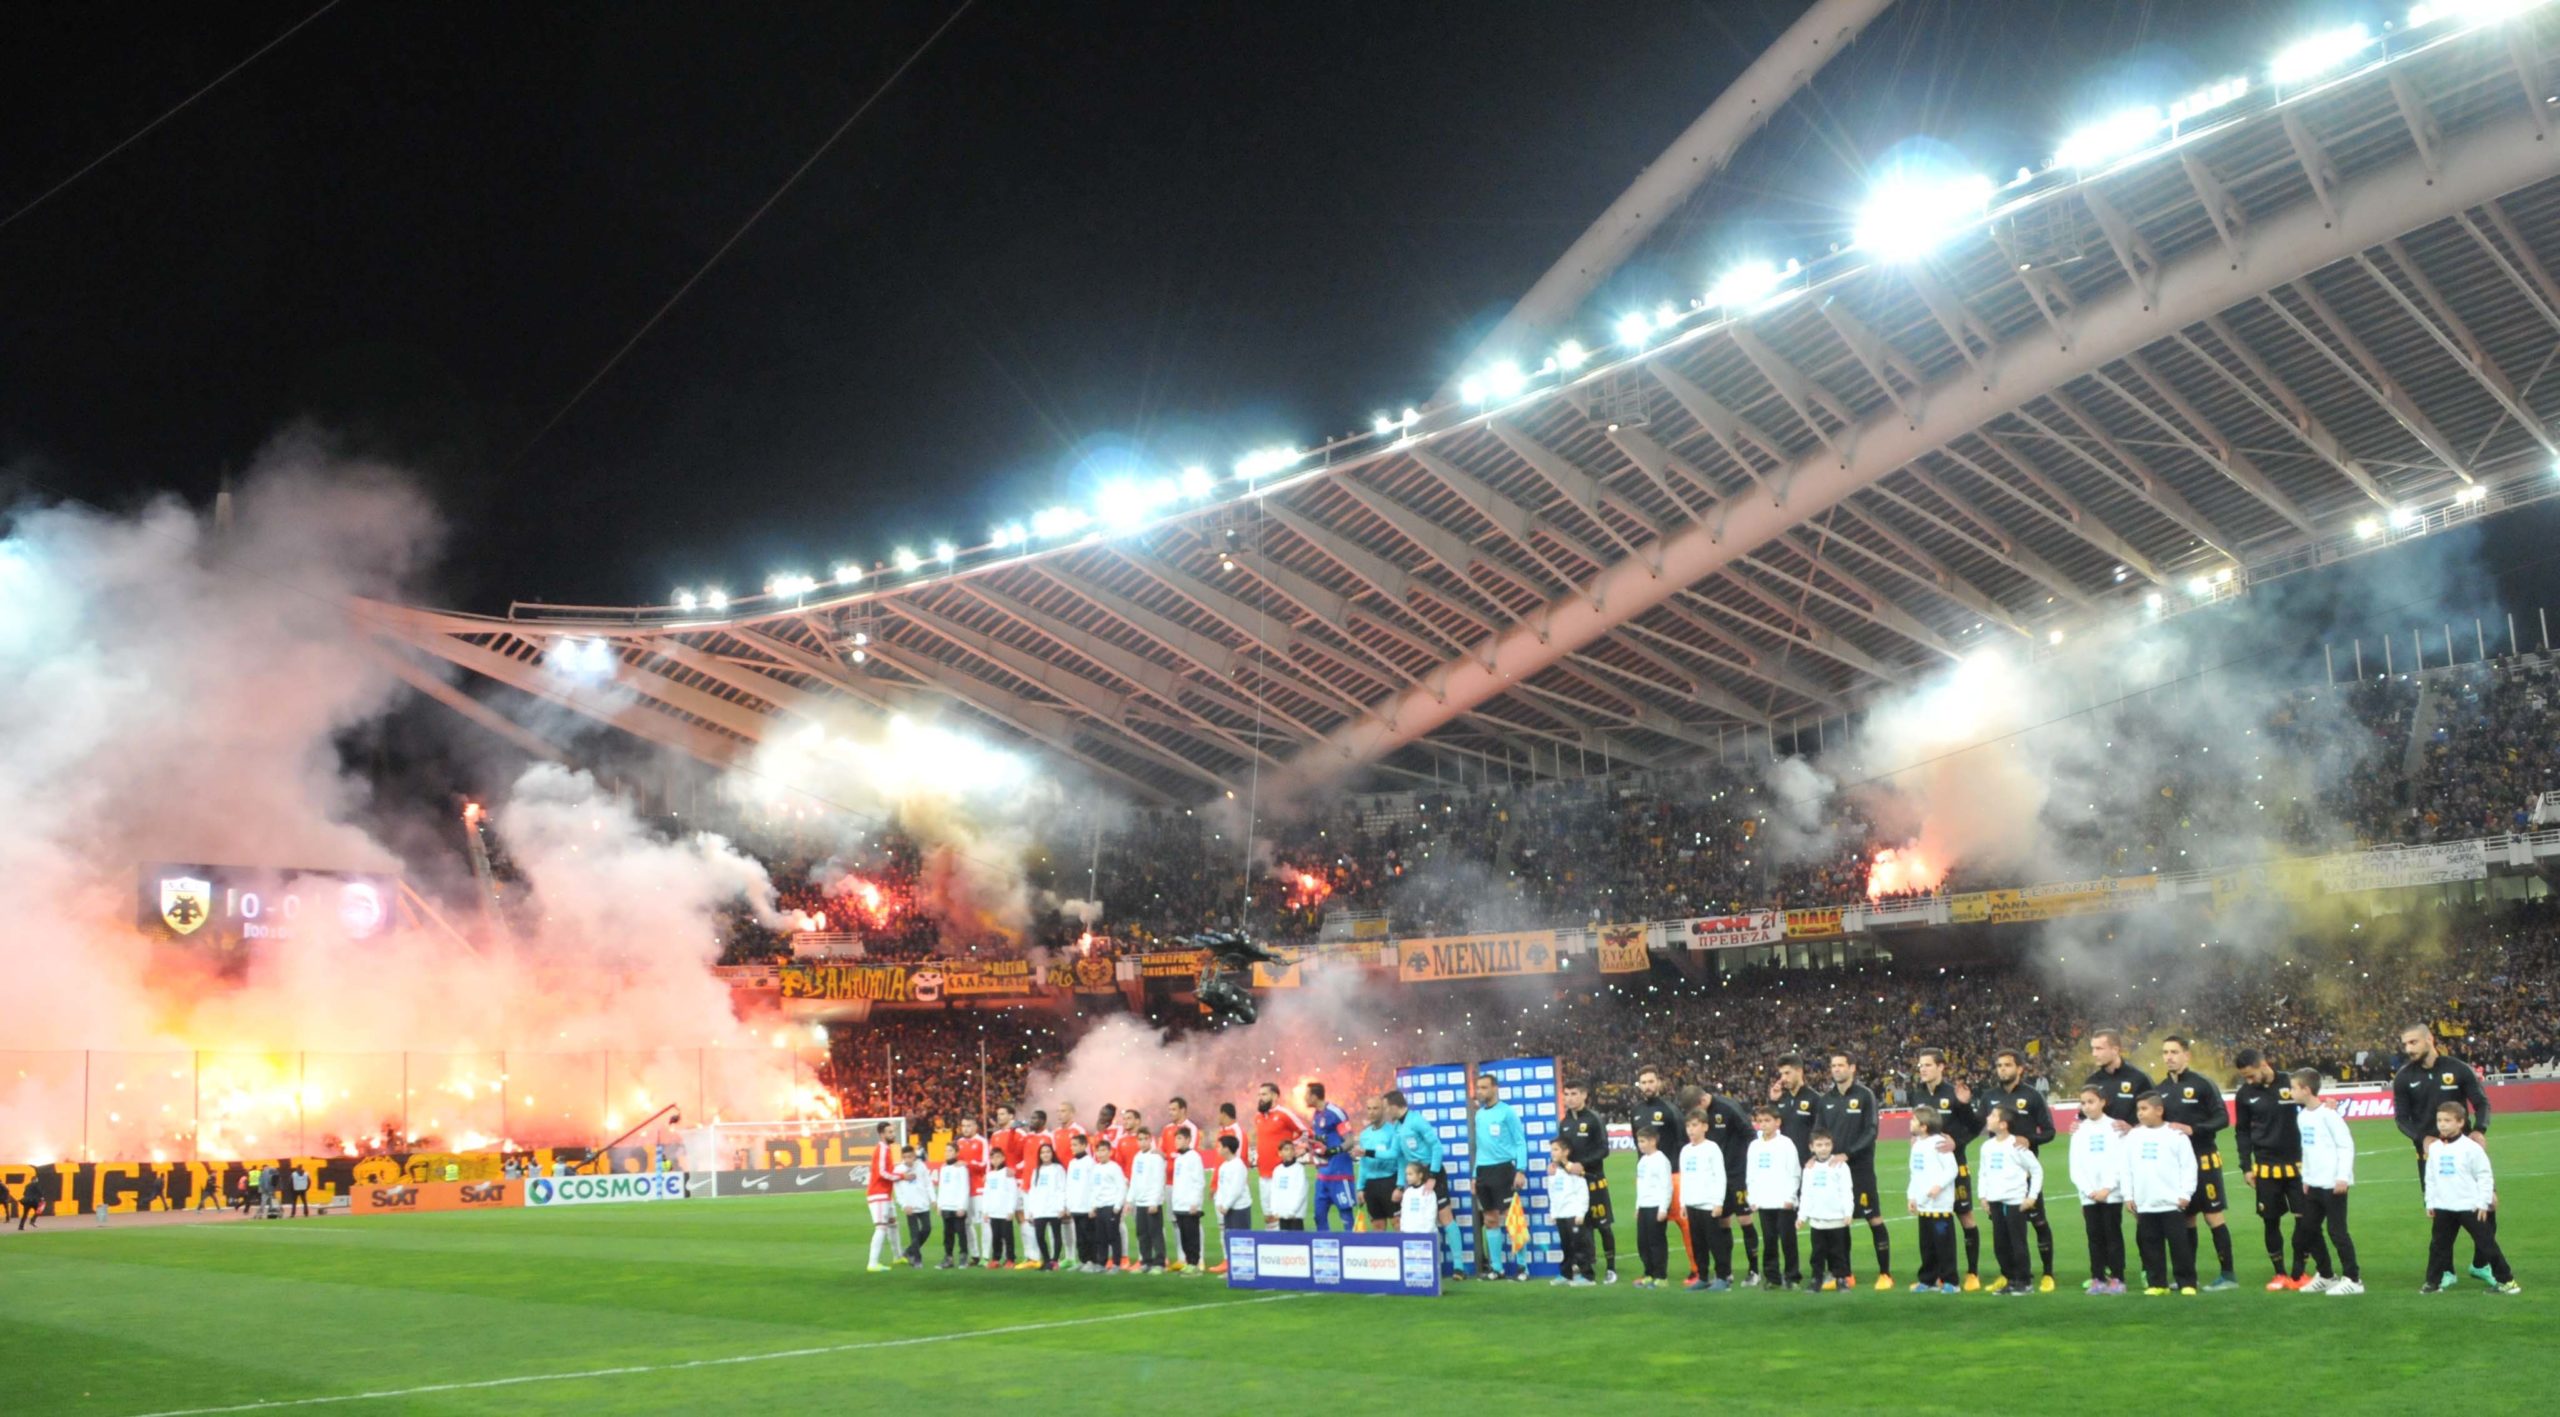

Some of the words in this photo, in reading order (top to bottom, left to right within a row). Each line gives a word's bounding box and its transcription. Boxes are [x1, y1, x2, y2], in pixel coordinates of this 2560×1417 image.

[1760, 912, 1777, 930] 21
[1698, 930, 1771, 947] ΠΡΕΒΕΖΑ
[1432, 939, 1522, 977] ΜΕΝΙΔΙ
[1260, 1255, 1307, 1267] novasports
[1345, 1256, 1396, 1270] novasports
